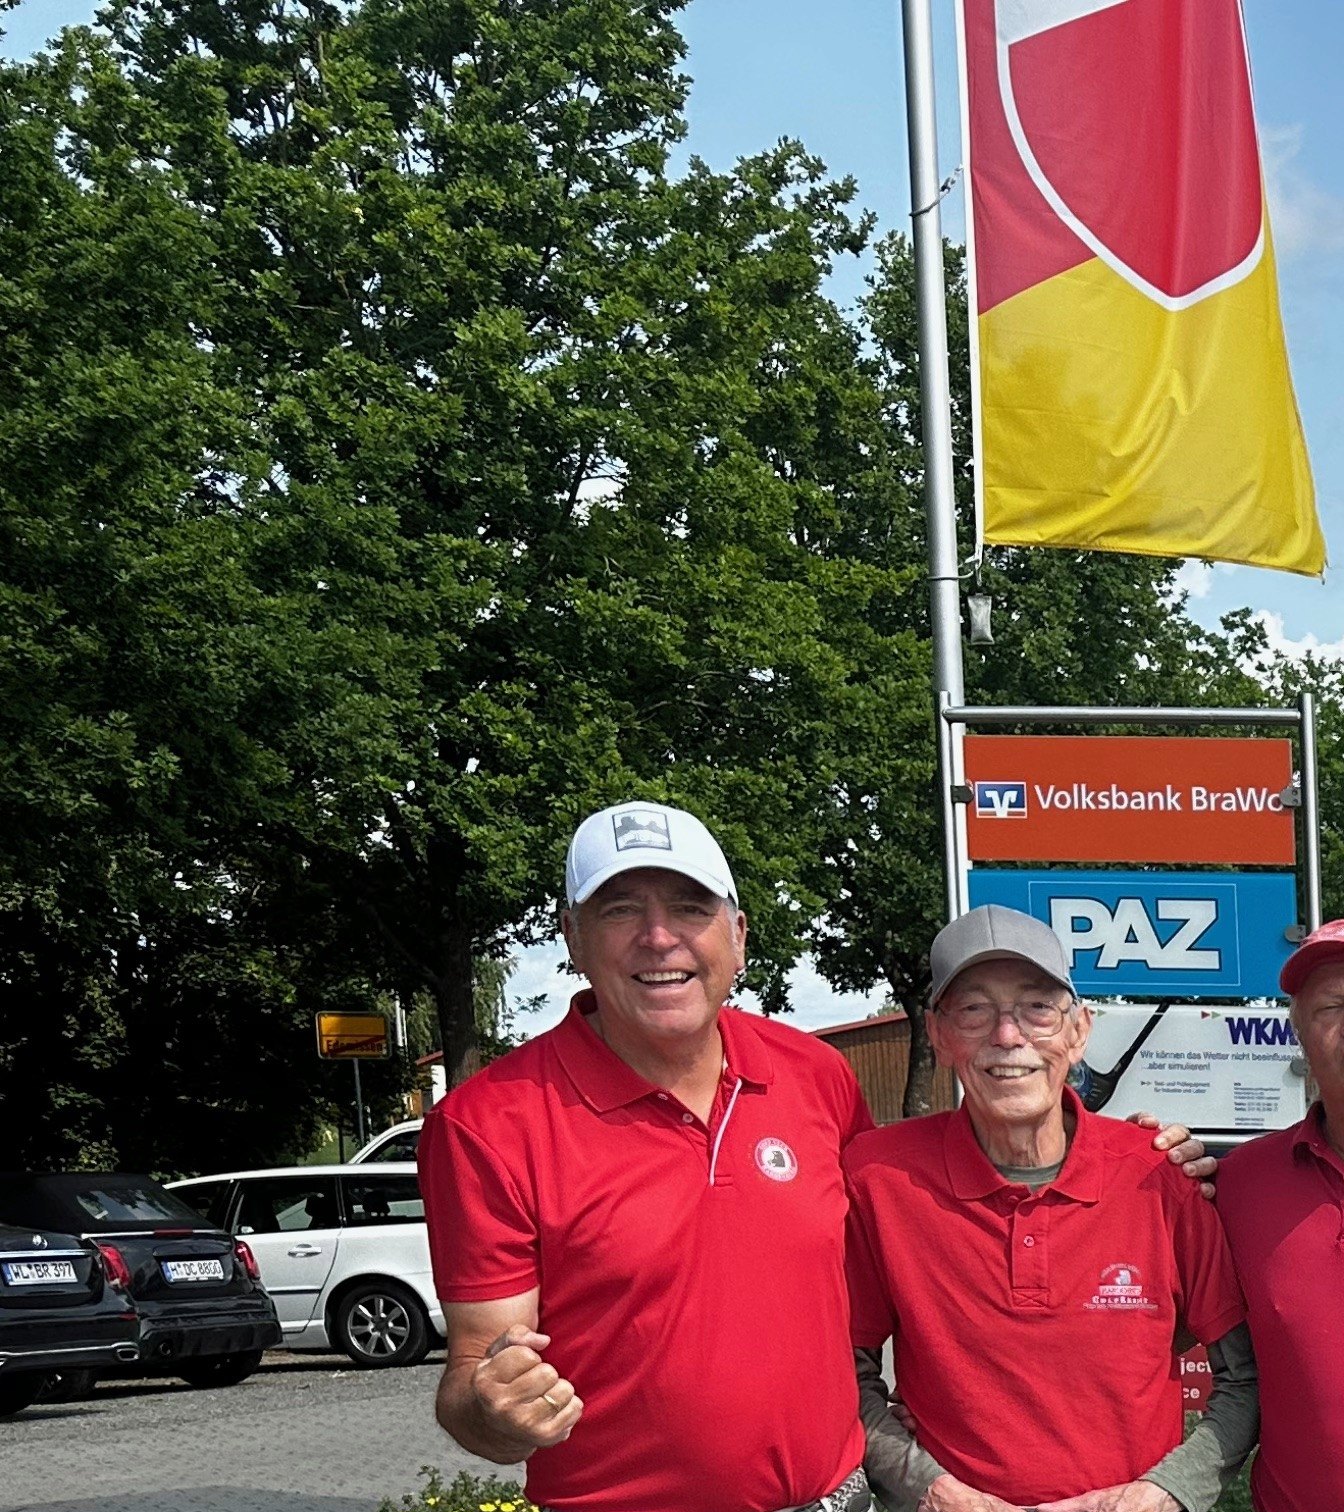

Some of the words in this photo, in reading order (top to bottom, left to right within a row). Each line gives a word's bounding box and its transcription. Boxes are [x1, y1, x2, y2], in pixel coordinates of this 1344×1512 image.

[1034, 782, 1183, 811] Volksbank
[1049, 896, 1222, 972] PAZ
[1225, 1016, 1299, 1046] WKM
[1140, 1050, 1153, 1060] Wir
[1186, 1051, 1201, 1060] das
[1231, 1051, 1250, 1061] nicht
